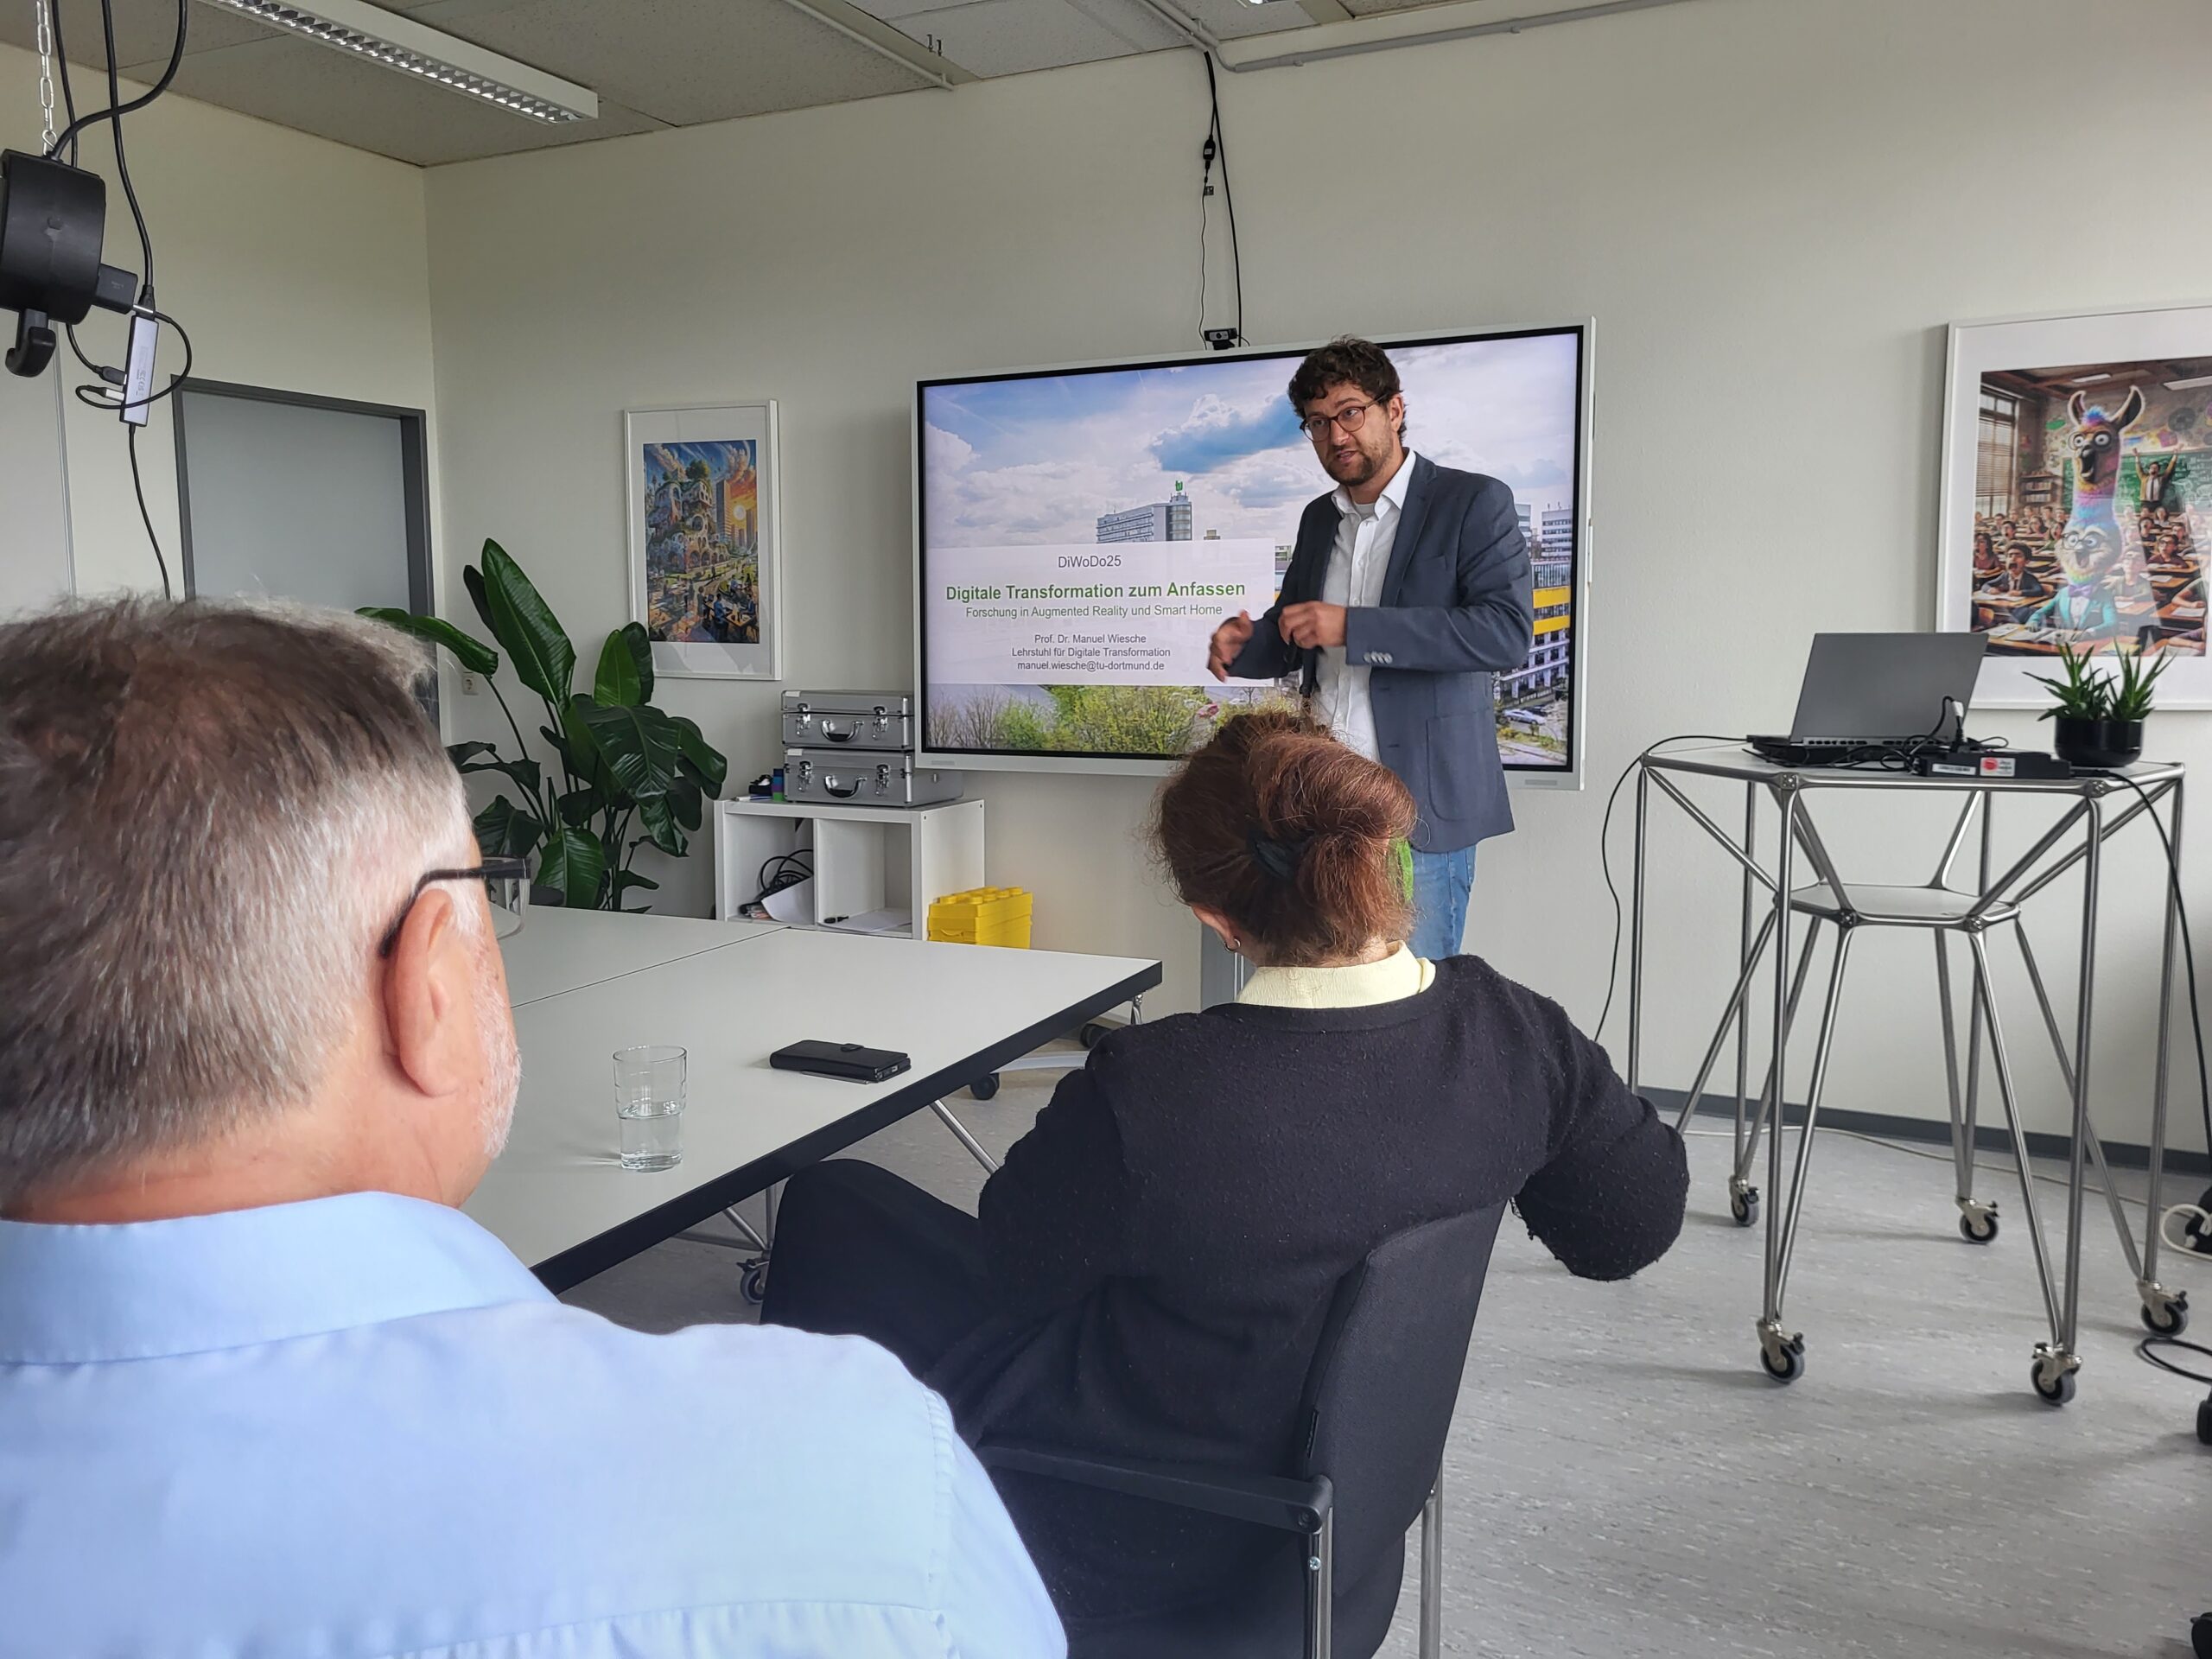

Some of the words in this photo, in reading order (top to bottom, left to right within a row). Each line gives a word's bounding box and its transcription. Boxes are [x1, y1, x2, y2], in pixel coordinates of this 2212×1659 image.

[1058, 555, 1122, 569] DiWoDo25
[946, 586, 1001, 603] Digitale
[1006, 583, 1123, 599] Transformation
[1128, 586, 1162, 597] zum
[1166, 582, 1245, 596] Anfassen
[966, 607, 1017, 619] Forschung
[1020, 607, 1029, 617] in
[1031, 606, 1089, 619] Augmented
[1092, 605, 1128, 618] Reality
[1131, 605, 1151, 615] und
[1154, 605, 1186, 615] Smart
[1190, 604, 1223, 614] Home
[1034, 634, 1055, 644] Prof.
[1058, 634, 1070, 643] Dr.
[1072, 633, 1105, 644] Manuel
[1107, 633, 1147, 644] Wiesche
[1012, 648, 1052, 657] Lehrstuhl
[1053, 648, 1065, 657] für
[1067, 648, 1101, 658] Digitale
[1103, 647, 1171, 657] Transformation
[1017, 660, 1165, 672] manuel.wiesche@tu-dortmund.de
